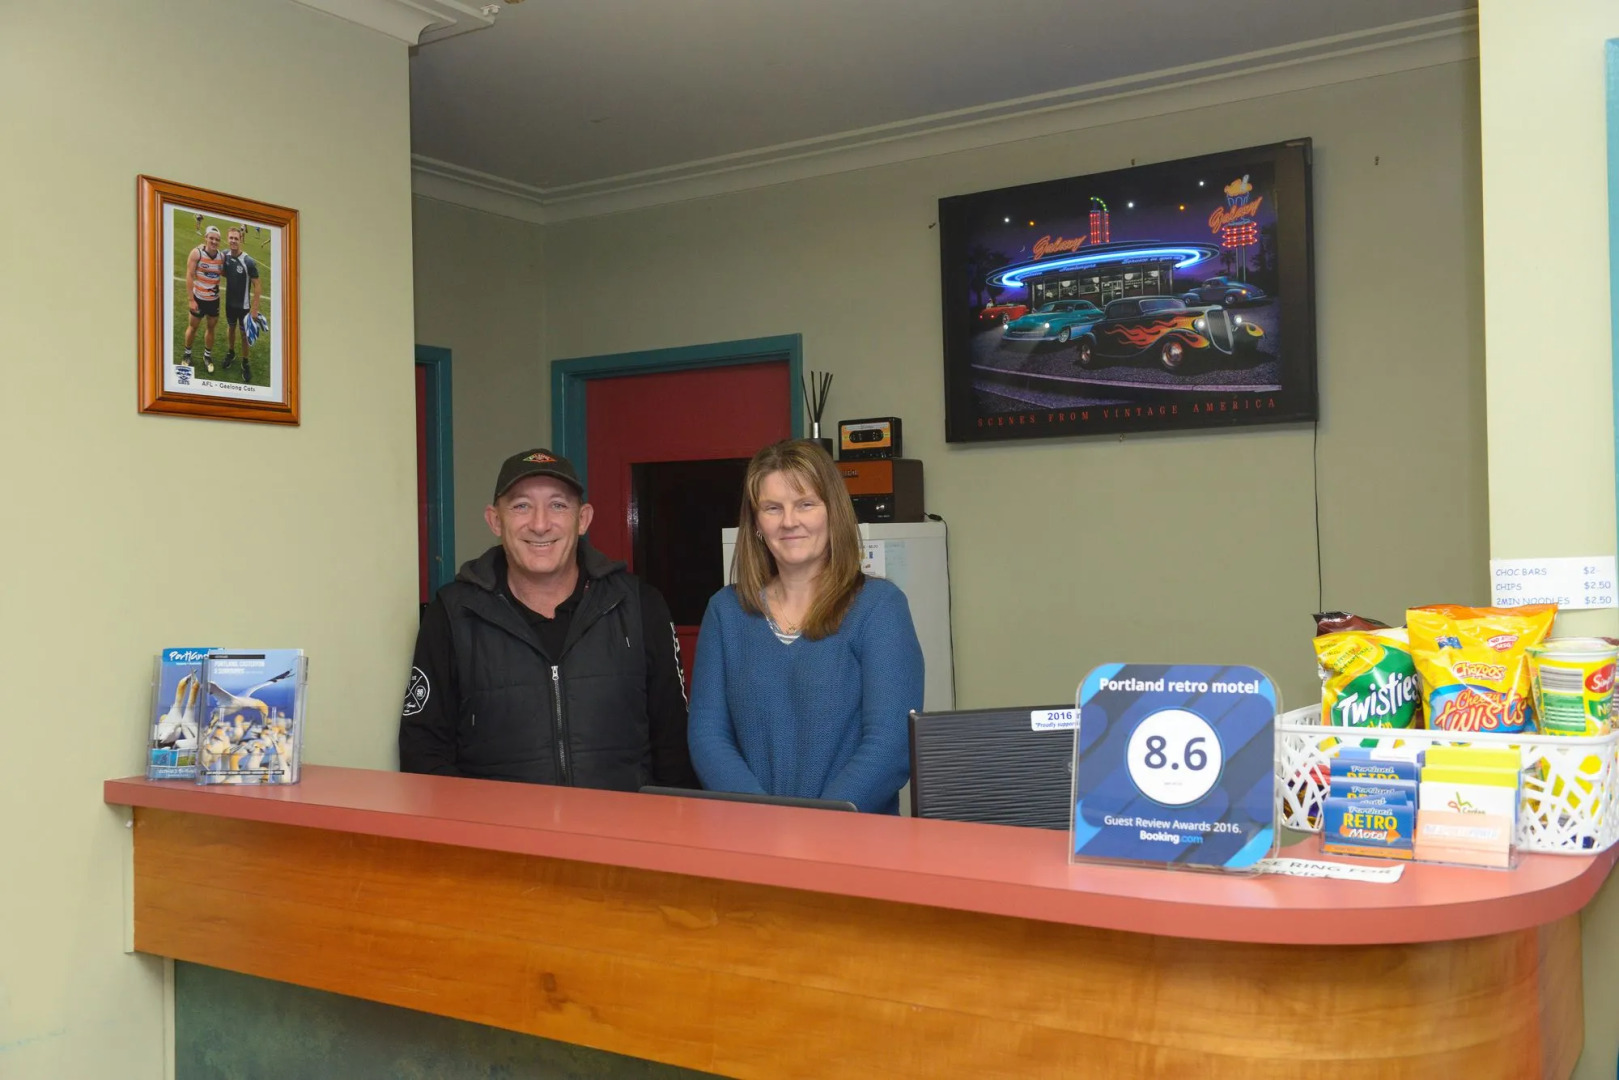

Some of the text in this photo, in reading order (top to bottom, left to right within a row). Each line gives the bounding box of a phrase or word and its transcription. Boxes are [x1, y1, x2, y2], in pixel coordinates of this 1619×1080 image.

[220, 383, 242, 392] Geelong
[977, 398, 1277, 428] SCENES FROM VINTAGE AMERICA
[1496, 568, 1520, 577] CHOC
[1522, 567, 1547, 576] BARS
[1496, 581, 1612, 591] CHIPS $2.50
[1497, 597, 1520, 606] 2MIN
[1584, 595, 1612, 605] $2.50
[1099, 677, 1260, 694] Portland retro motel
[1337, 672, 1419, 727] Twisties
[1047, 711, 1072, 721] 2016
[1144, 735, 1208, 771] 8.6
[1104, 815, 1243, 834] Guest Review Awards 2016.
[1343, 812, 1398, 830] RETRO
[1139, 830, 1204, 845] Booking.com
[1348, 828, 1388, 841] Motel
